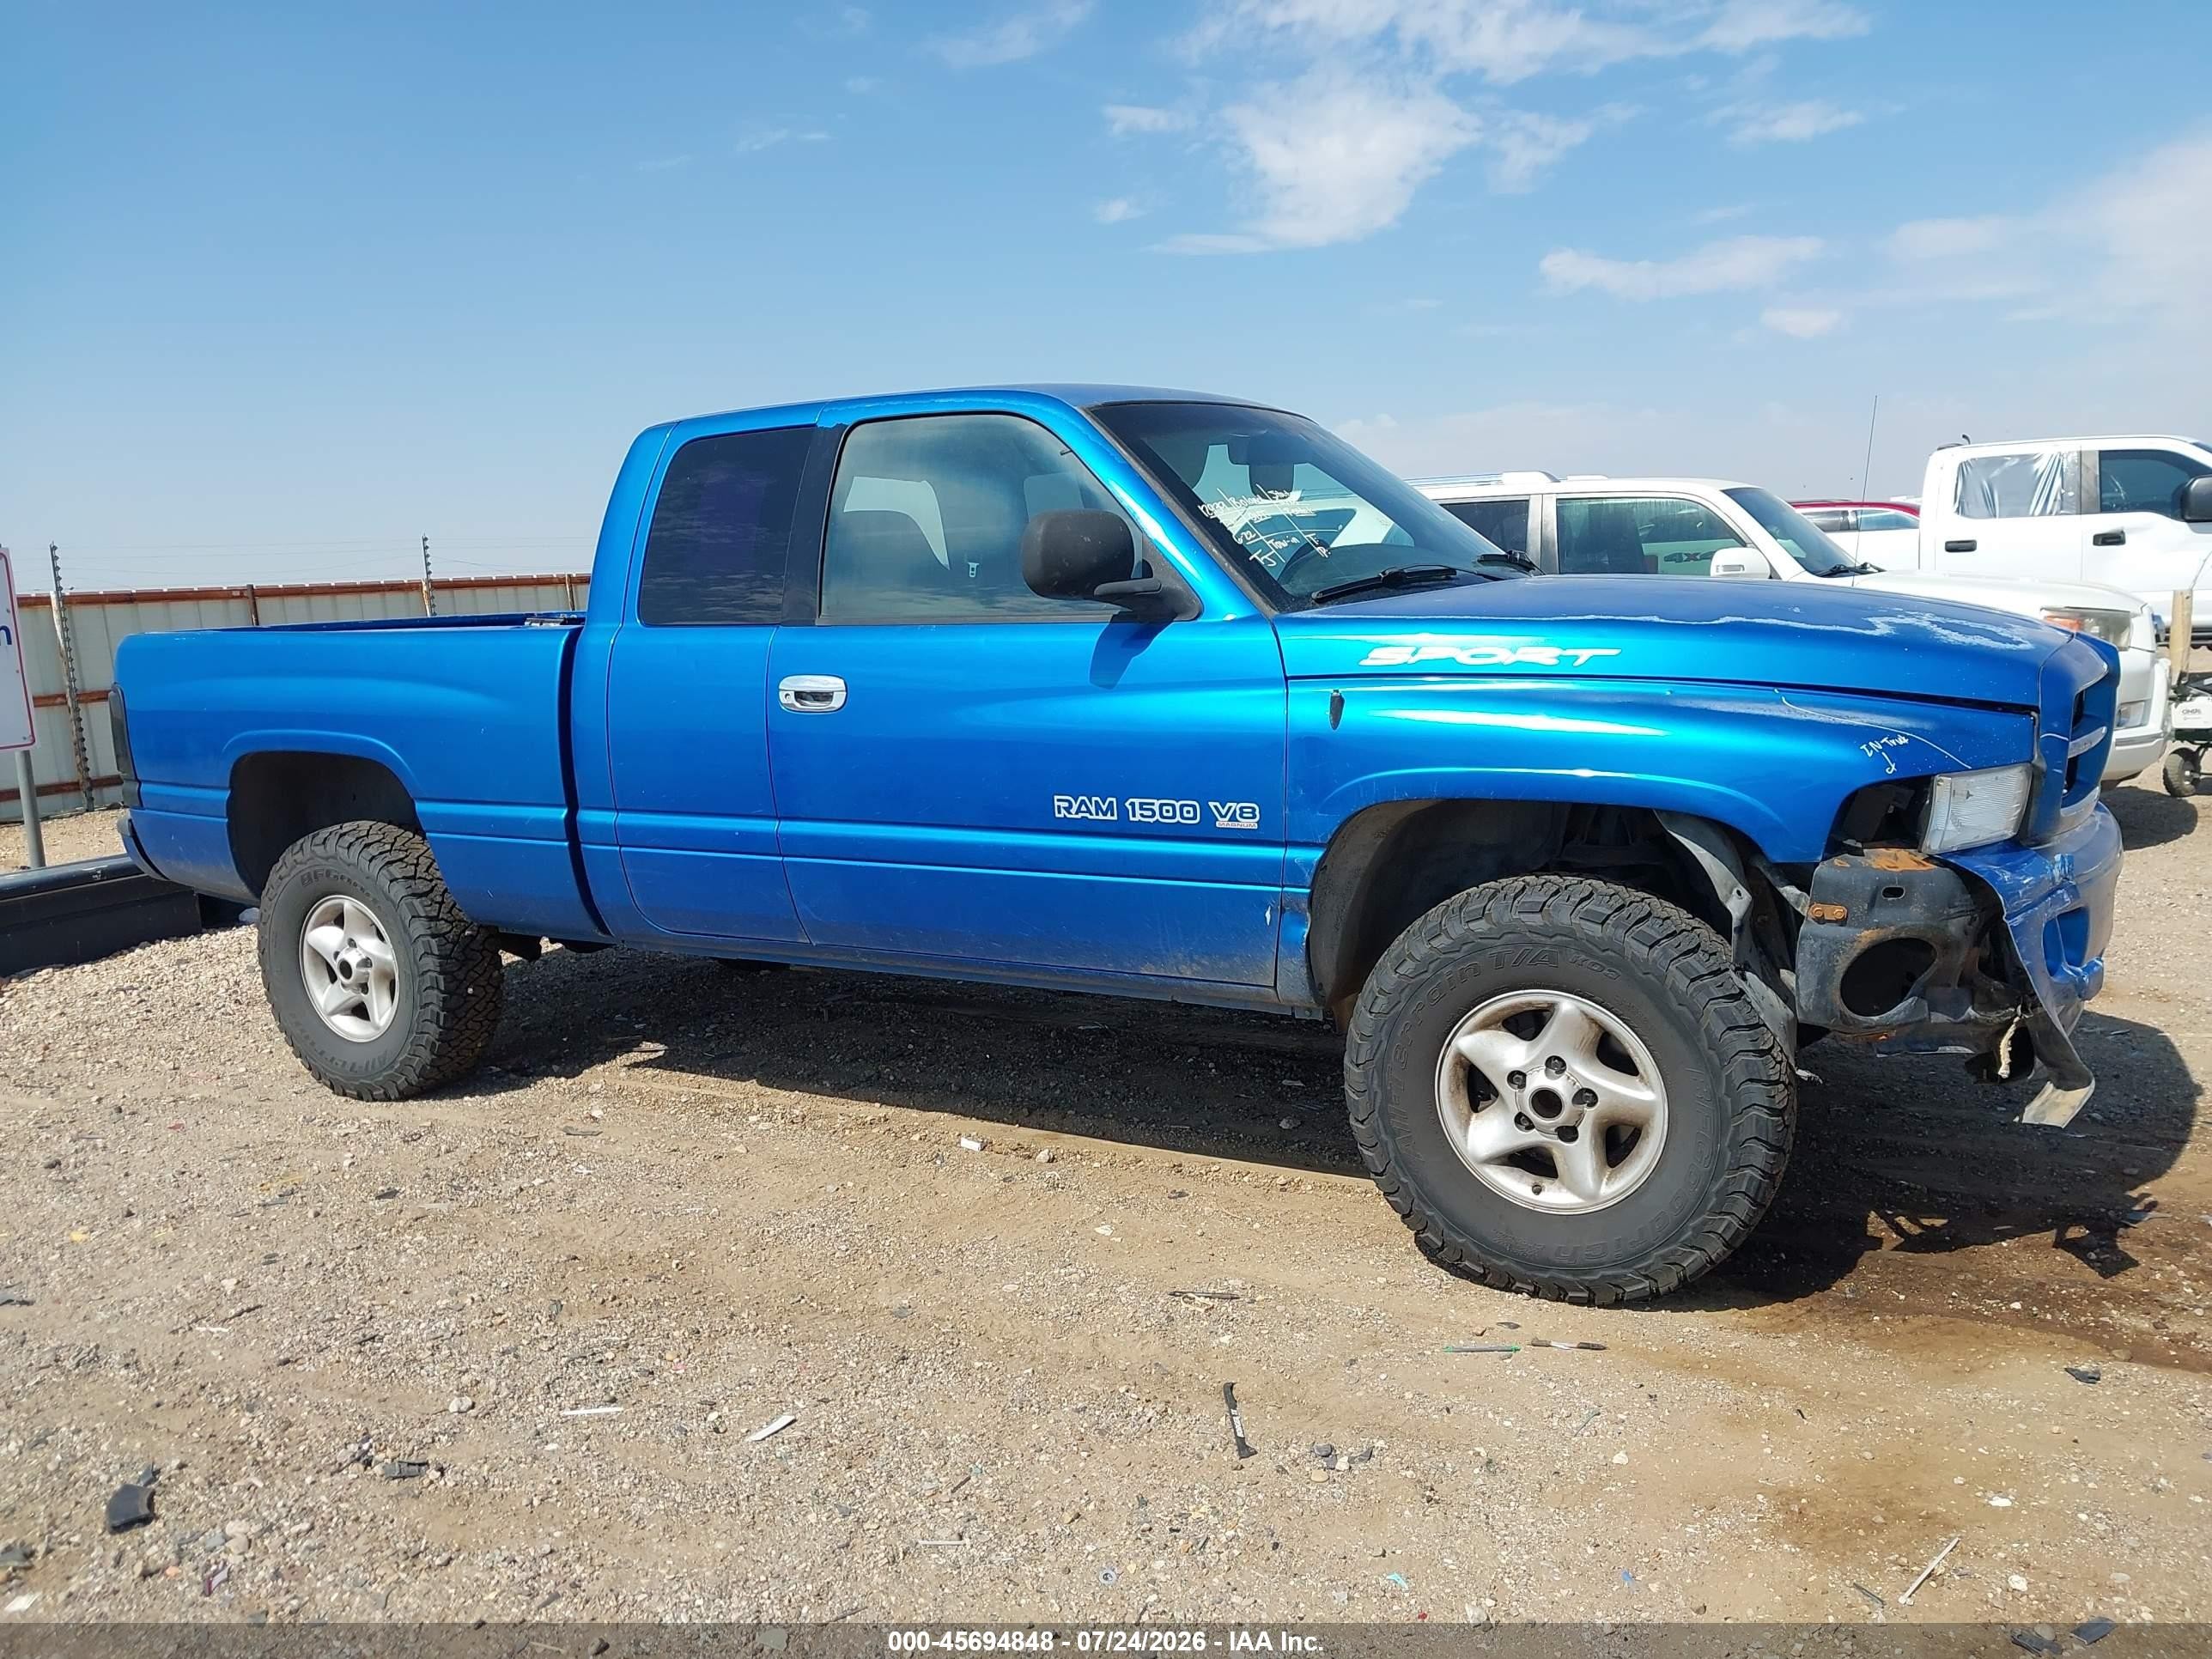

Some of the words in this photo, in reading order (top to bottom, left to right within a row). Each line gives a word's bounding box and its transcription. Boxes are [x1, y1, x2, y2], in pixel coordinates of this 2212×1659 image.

[1358, 646, 1622, 667] SPORT
[1054, 795, 1118, 821] RAM
[1125, 798, 1200, 823] 1500
[1208, 801, 1261, 823] V8
[1488, 947, 1559, 970] T/A
